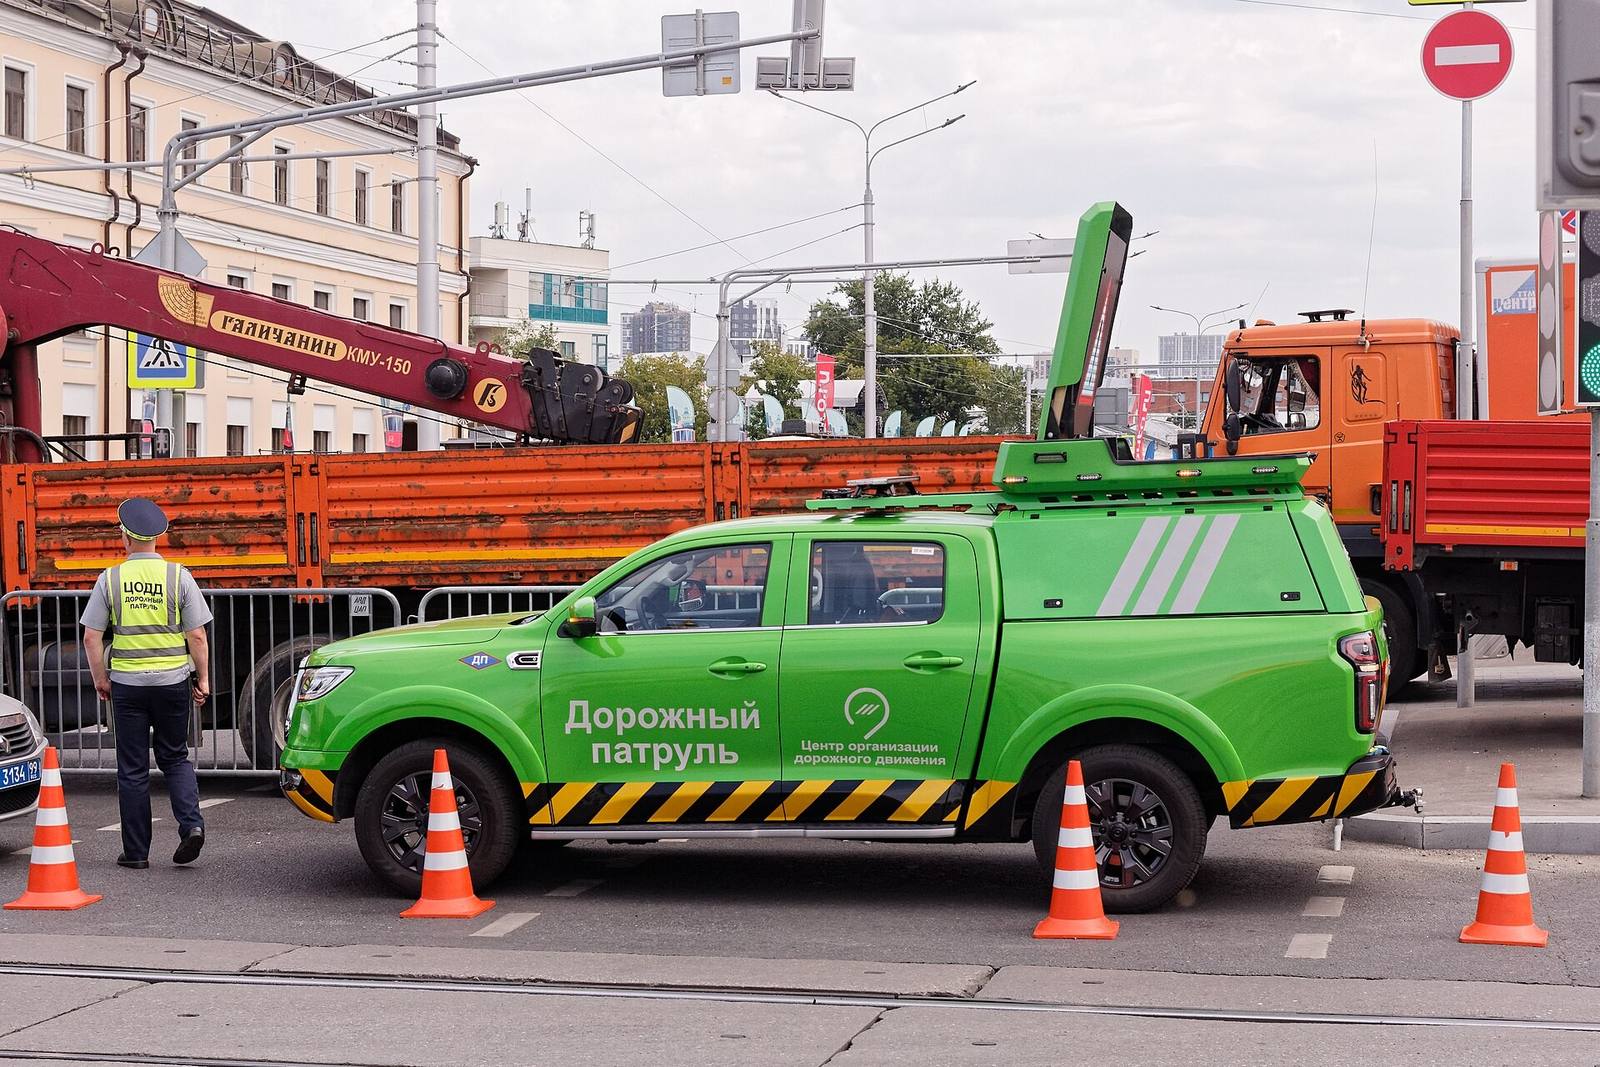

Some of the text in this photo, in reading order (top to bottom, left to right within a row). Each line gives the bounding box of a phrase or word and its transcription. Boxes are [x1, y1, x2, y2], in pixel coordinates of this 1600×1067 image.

[221, 314, 338, 358] ГАЛИЧАНИН
[346, 345, 412, 375] КМУ-150
[123, 581, 164, 597] ЦОДД
[471, 655, 489, 666] ДП
[564, 699, 761, 735] Дорожный
[591, 742, 740, 772] патруль
[800, 740, 939, 753] Центр организации
[793, 754, 947, 766] дорожного движения
[2, 761, 38, 786] 3134 99
